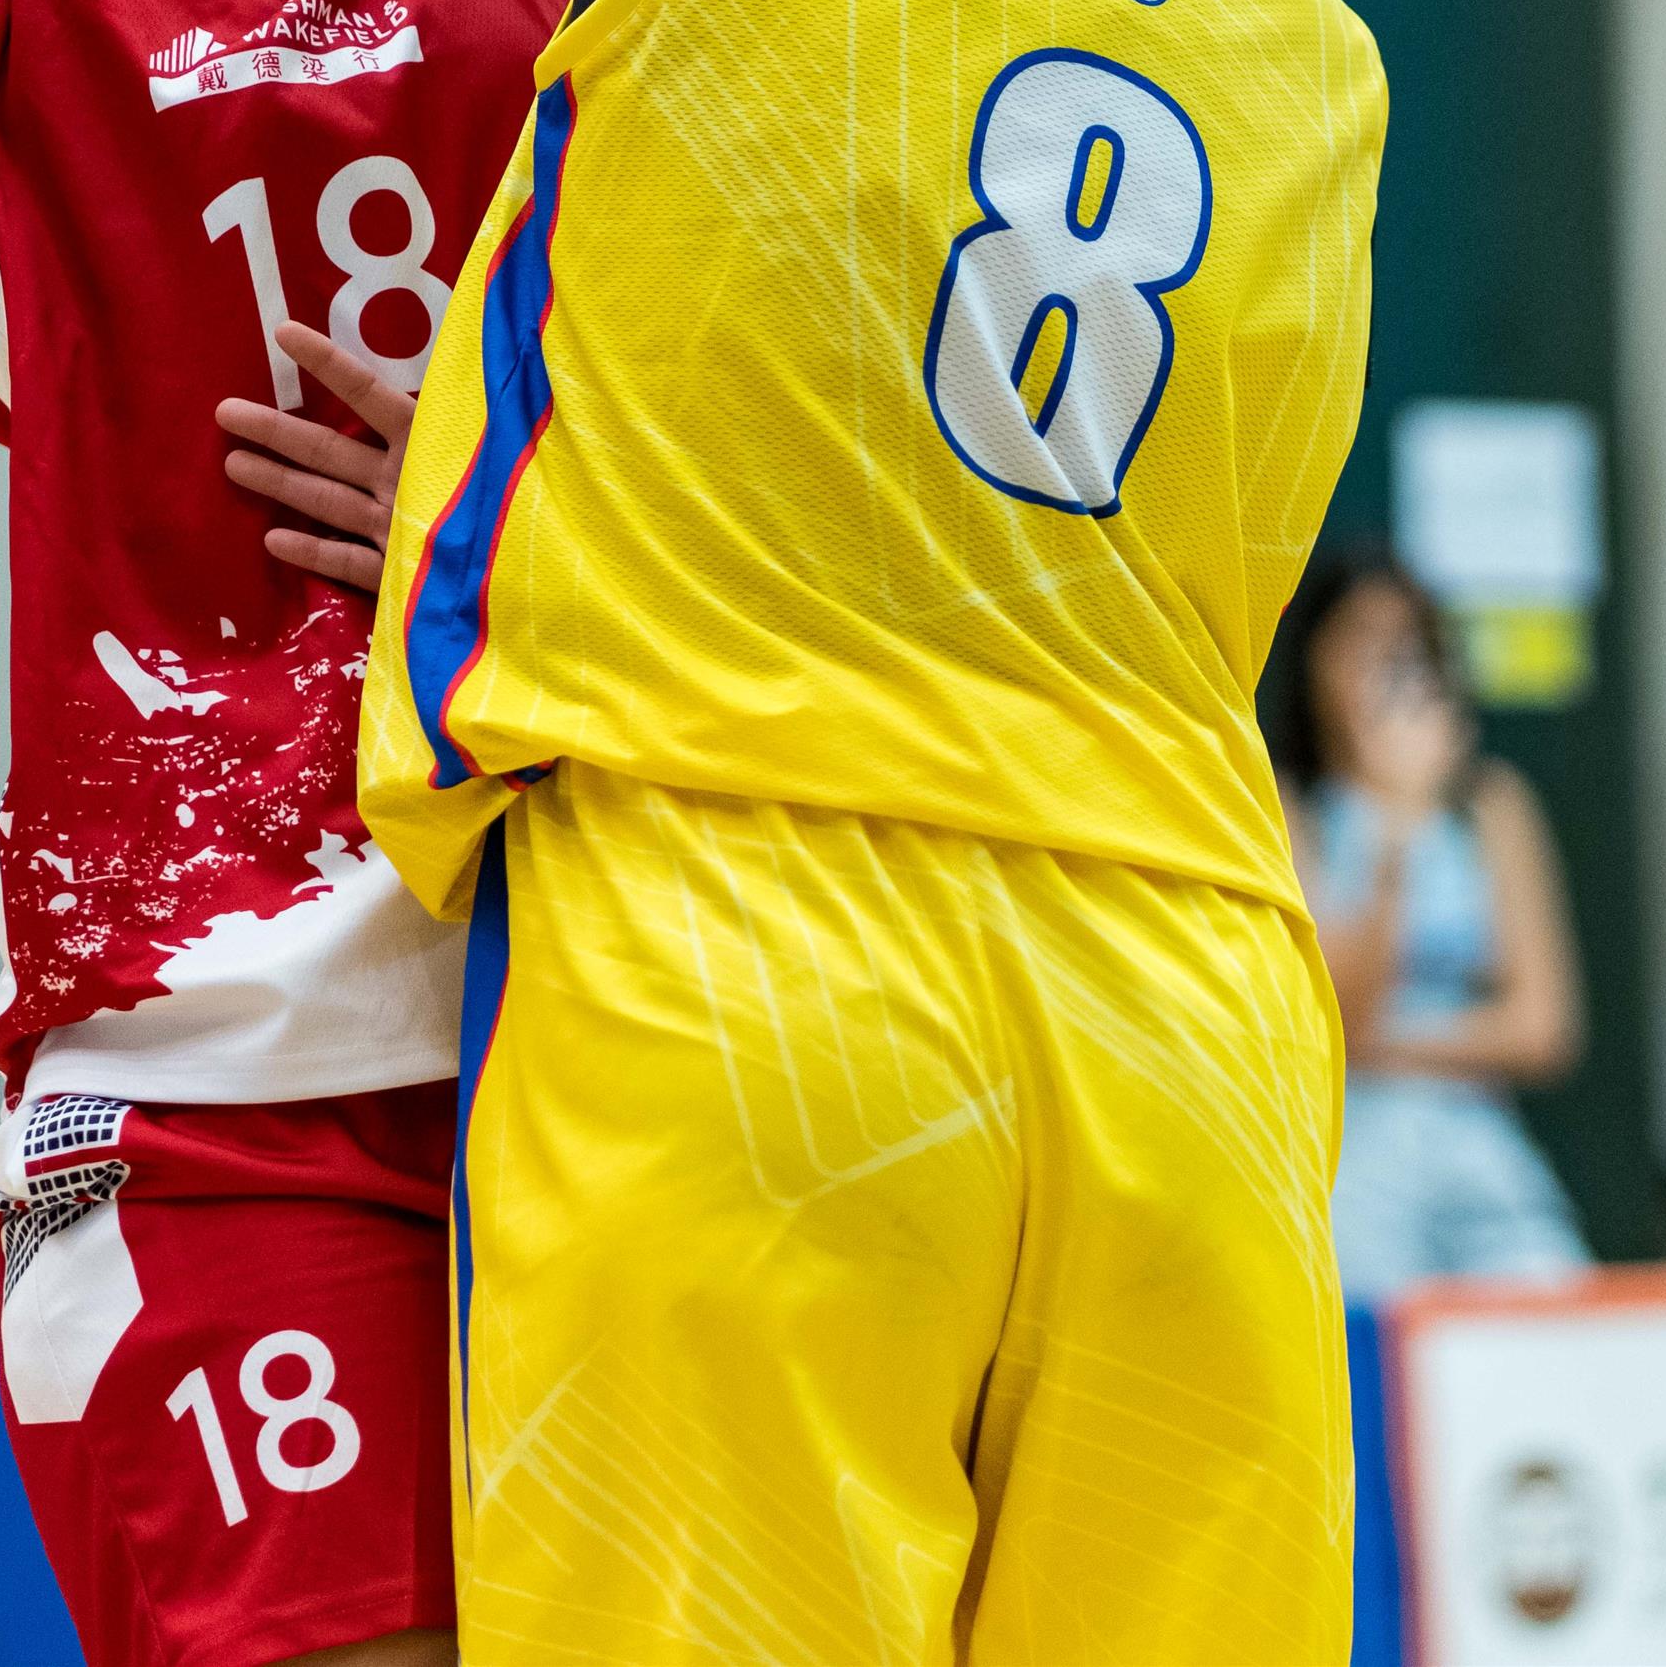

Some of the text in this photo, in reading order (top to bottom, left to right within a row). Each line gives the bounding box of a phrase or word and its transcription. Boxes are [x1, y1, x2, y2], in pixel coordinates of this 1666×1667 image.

[242, 4, 409, 47] WAKEFIELD
[383, 0, 399, 17] &
[196, 49, 381, 93] 戴德梁行
[202, 155, 453, 411] 18
[923, 47, 1213, 517] 8
[165, 1329, 361, 1527] 18
